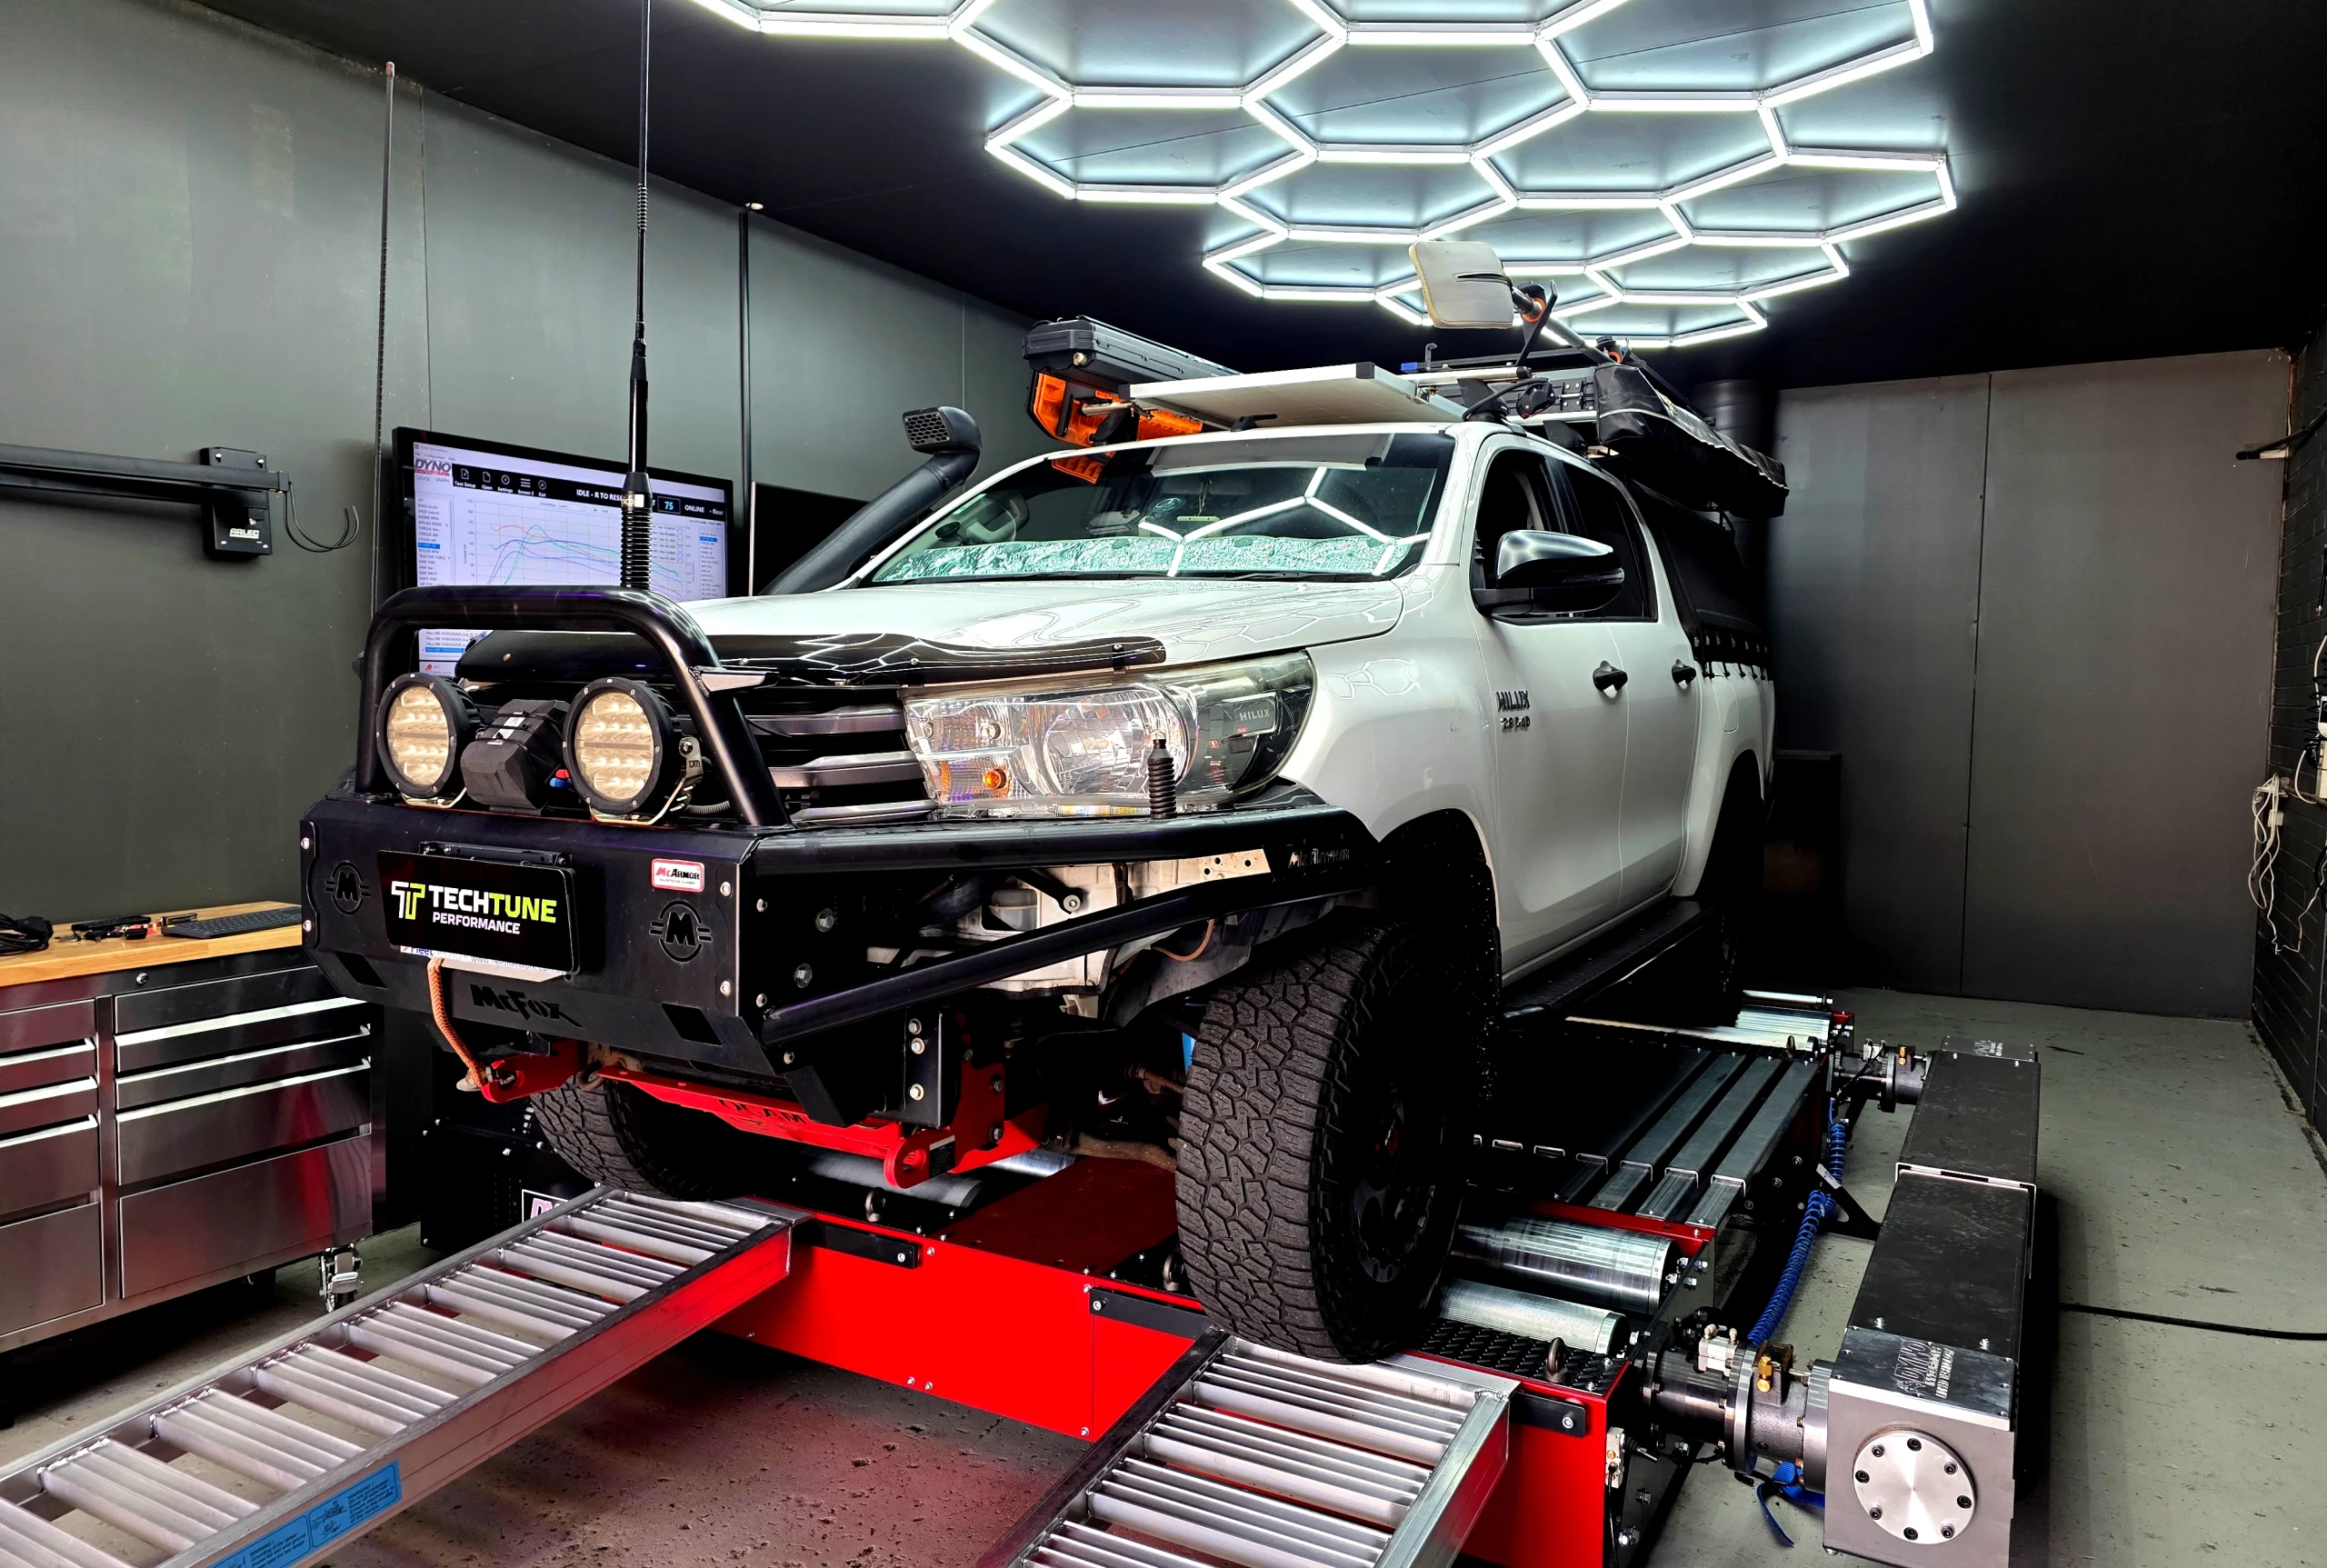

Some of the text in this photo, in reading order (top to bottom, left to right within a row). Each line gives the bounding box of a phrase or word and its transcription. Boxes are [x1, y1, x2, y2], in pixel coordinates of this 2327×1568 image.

[414, 458, 451, 472] DYNO
[576, 488, 589, 497] IDLE
[664, 501, 674, 510] 75
[684, 504, 704, 513] ONLINE
[1495, 690, 1530, 712] HILUX
[1239, 709, 1270, 721] HILUX
[428, 884, 557, 924] TECHTUNE
[432, 911, 521, 935] PERFORMANCE
